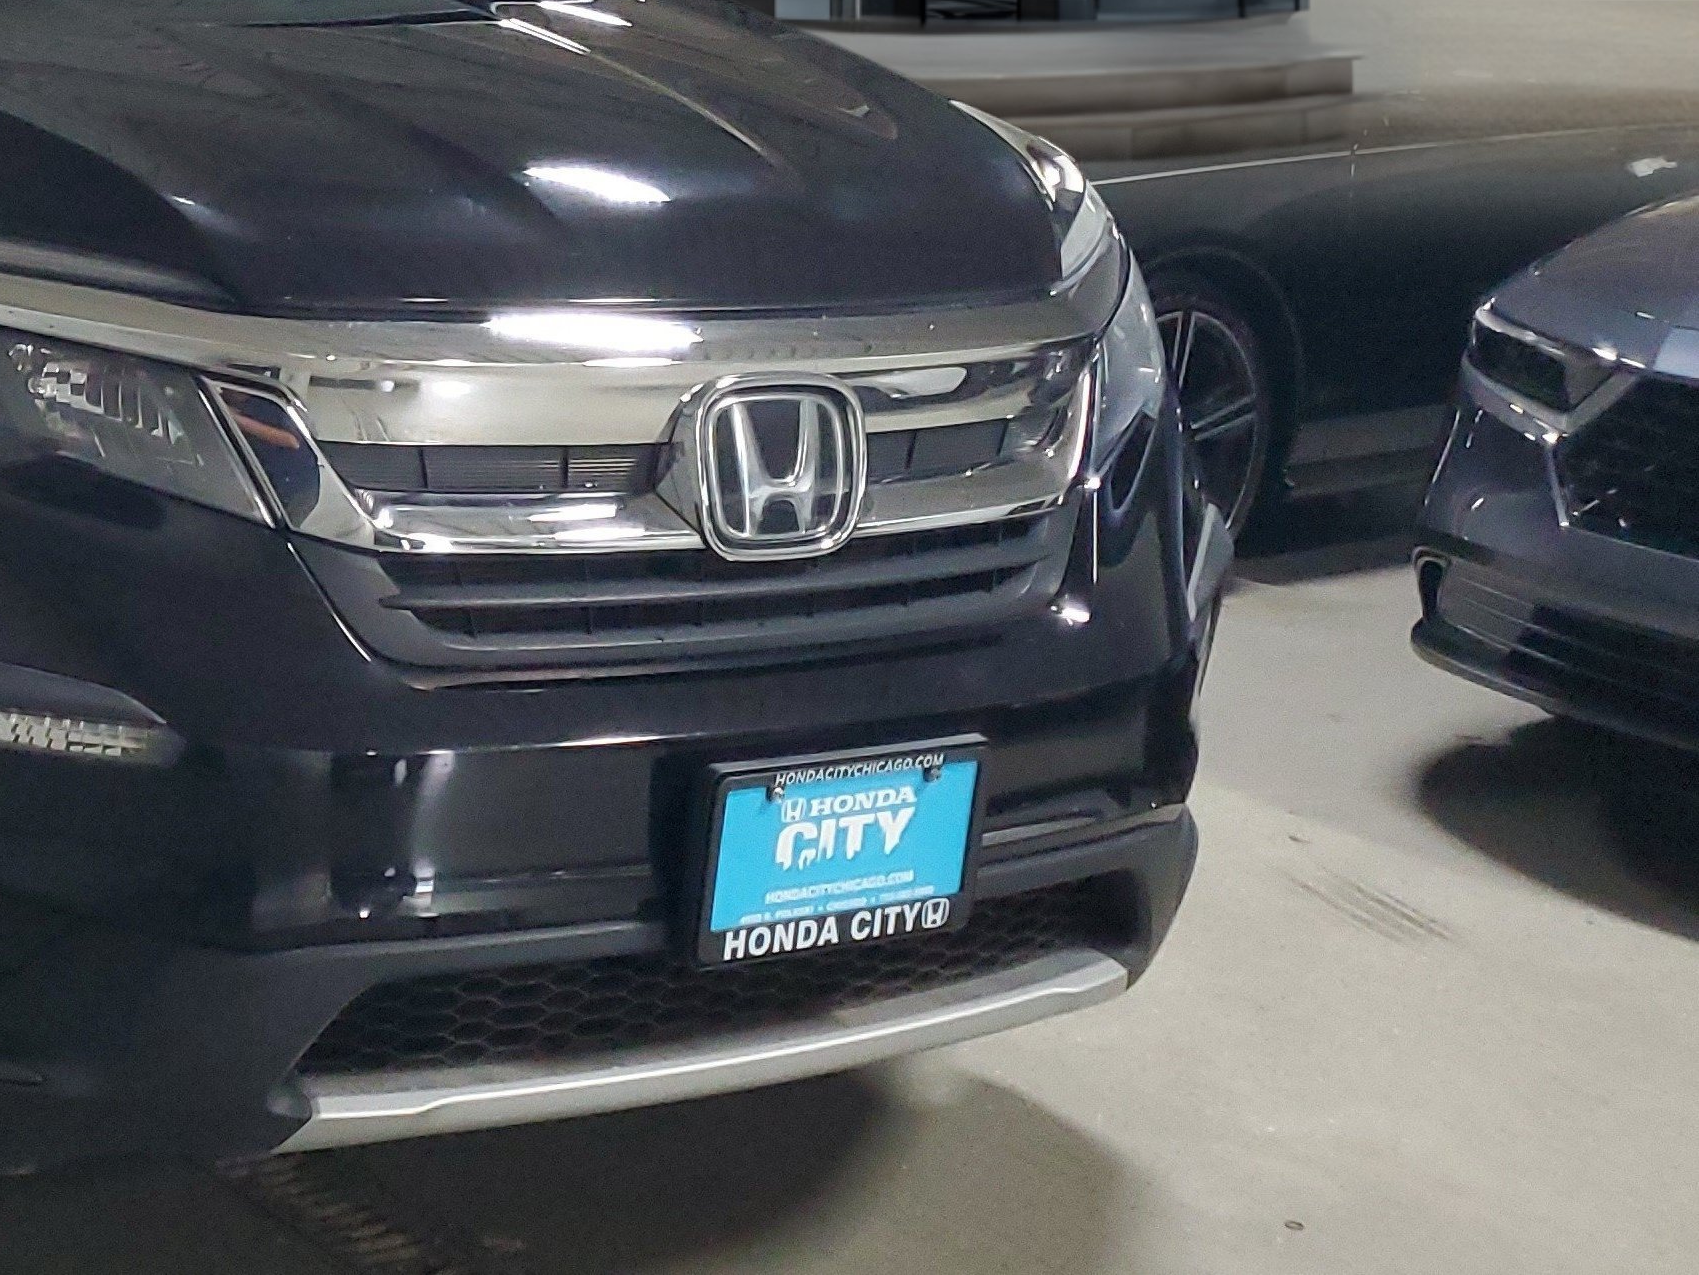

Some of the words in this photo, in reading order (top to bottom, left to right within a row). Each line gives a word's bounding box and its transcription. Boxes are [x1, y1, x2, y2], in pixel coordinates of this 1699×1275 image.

[775, 753, 944, 787] HONDACITYCHICAGO.COM
[809, 785, 917, 817] HONDA
[774, 806, 916, 870] CITY
[722, 916, 839, 961] HONDA
[850, 901, 924, 941] CITY
